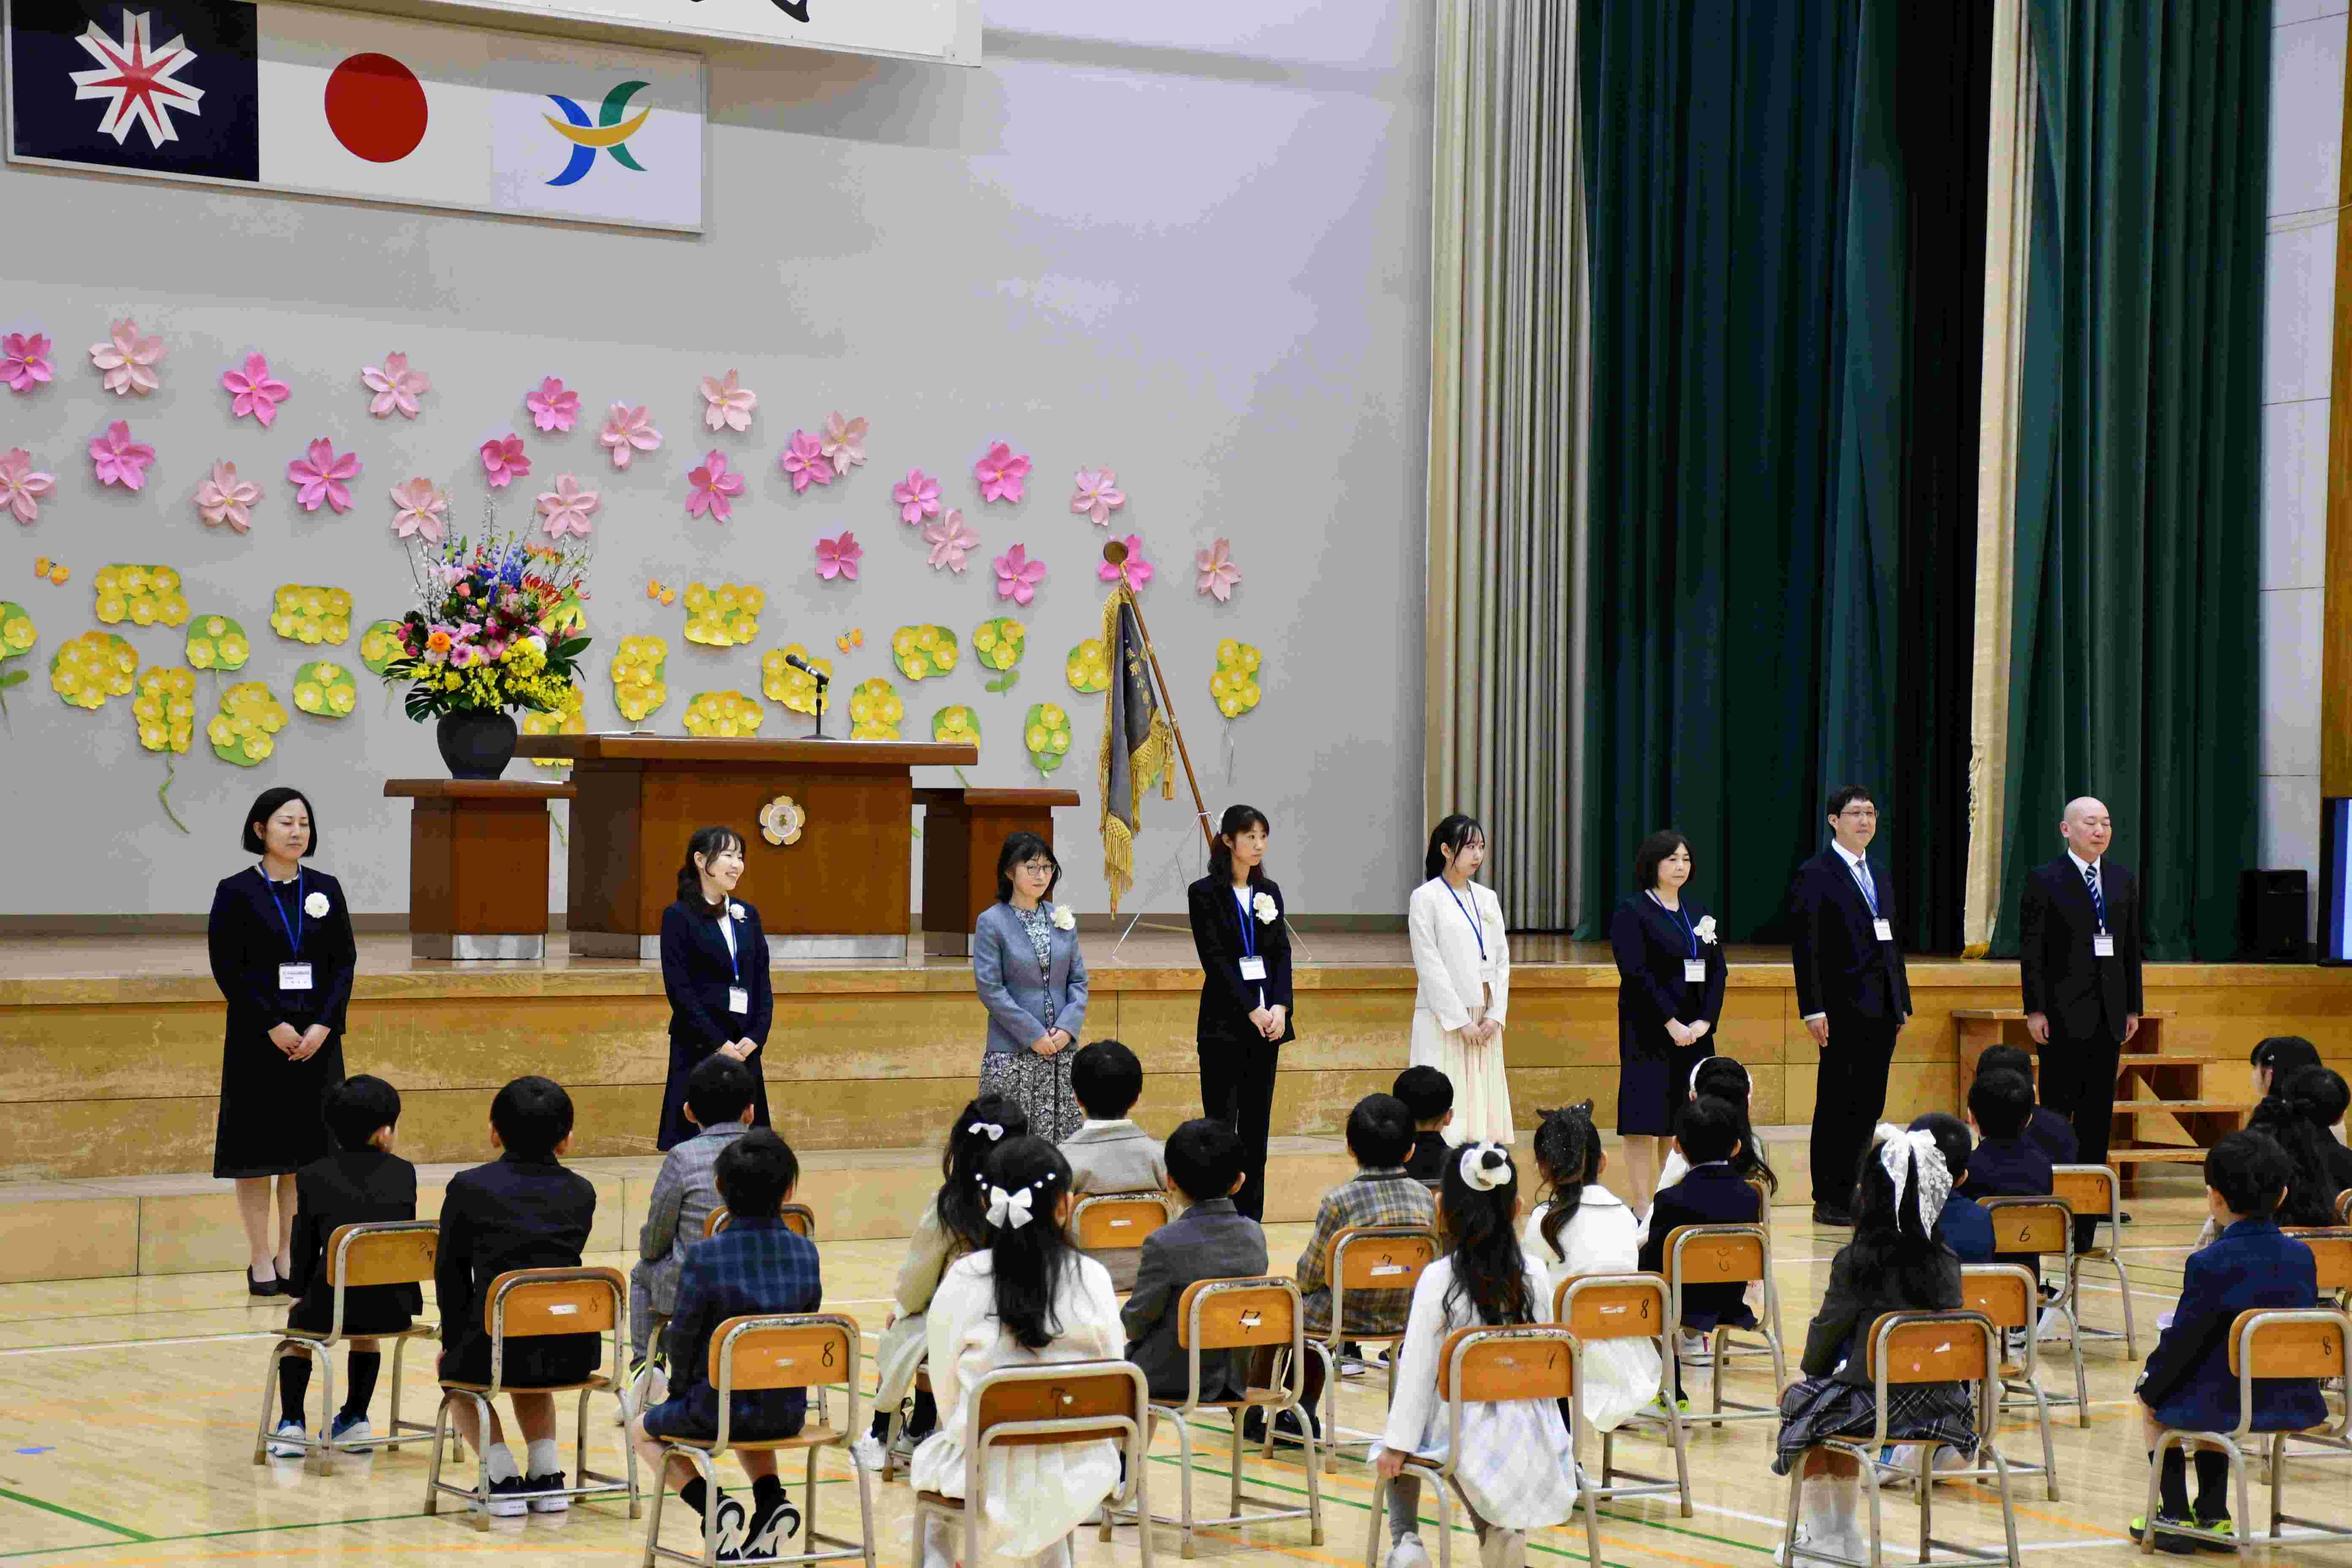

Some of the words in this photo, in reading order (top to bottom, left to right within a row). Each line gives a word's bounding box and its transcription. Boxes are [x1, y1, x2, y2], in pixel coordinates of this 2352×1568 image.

[2096, 1179, 2103, 1192] 7
[2019, 1224, 2031, 1242] 6
[1640, 1298, 1649, 1319] 8
[822, 1341, 835, 1368] 8
[2322, 1336, 2332, 1356] 8
